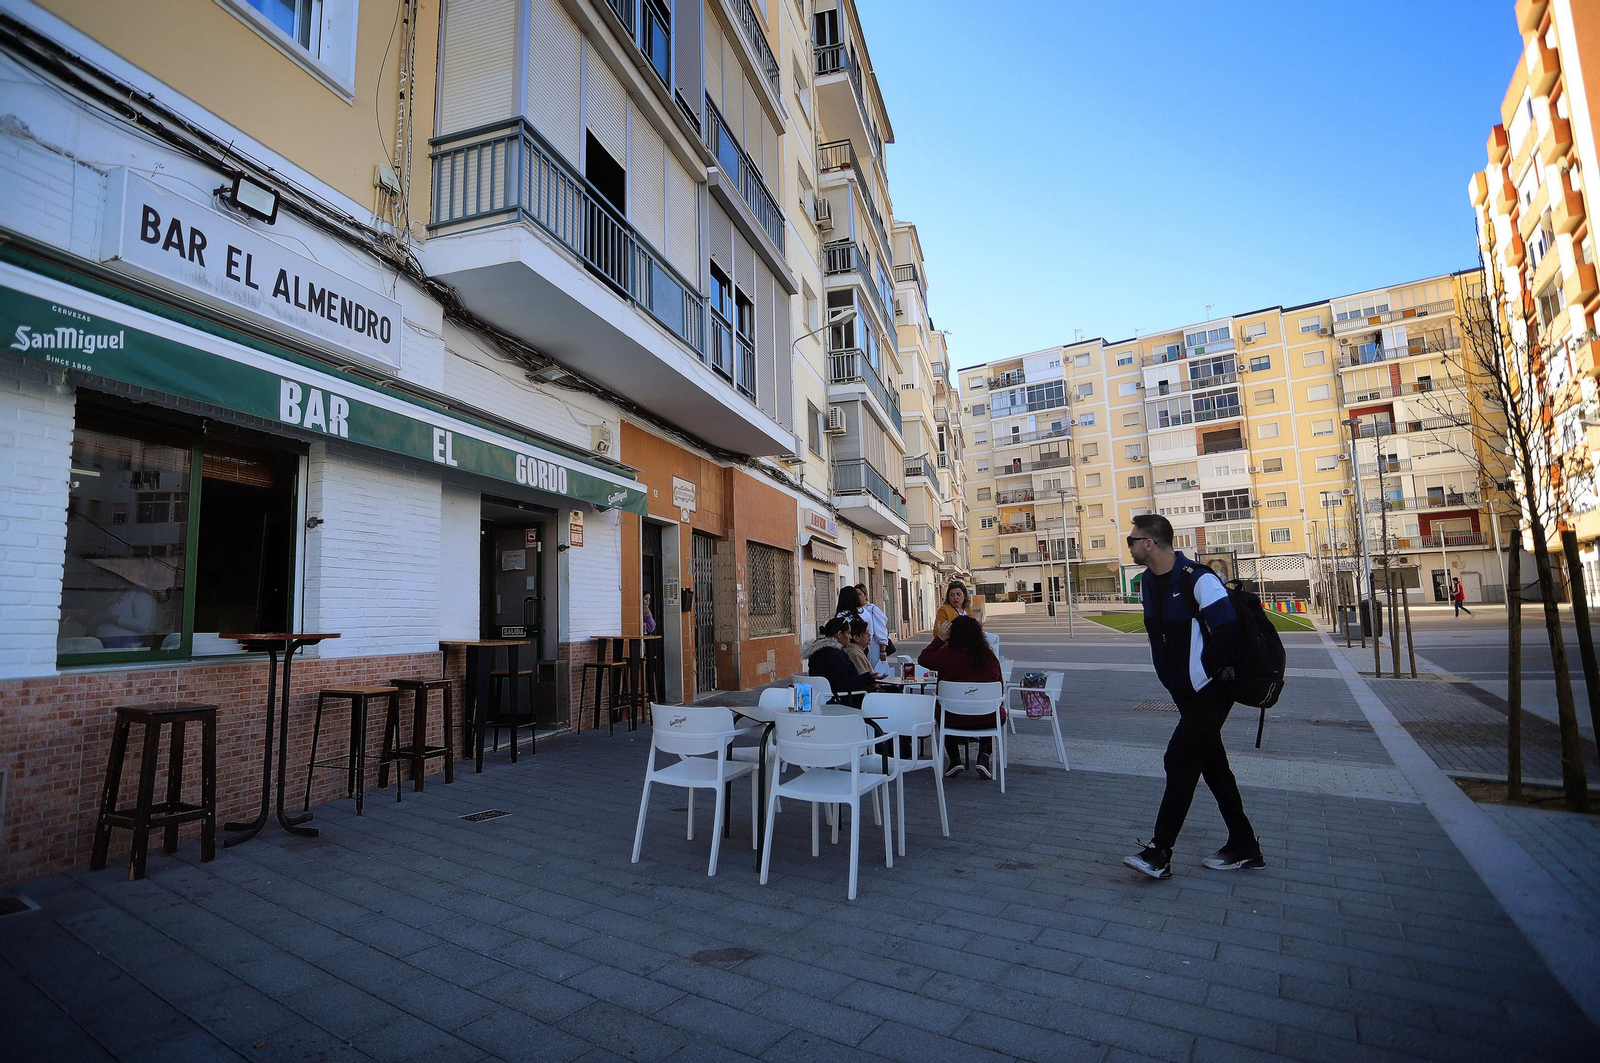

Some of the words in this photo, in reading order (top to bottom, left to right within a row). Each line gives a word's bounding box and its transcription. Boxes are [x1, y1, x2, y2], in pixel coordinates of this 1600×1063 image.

[140, 203, 208, 268] BAR
[225, 244, 260, 291] EL
[271, 268, 392, 344] ALMENDRO
[51, 305, 91, 322] CERVEZAS
[46, 354, 70, 367] SINCE
[72, 361, 92, 372] 1890
[279, 378, 350, 439] BAR
[432, 427, 458, 467] EL
[515, 453, 568, 495] GORDO
